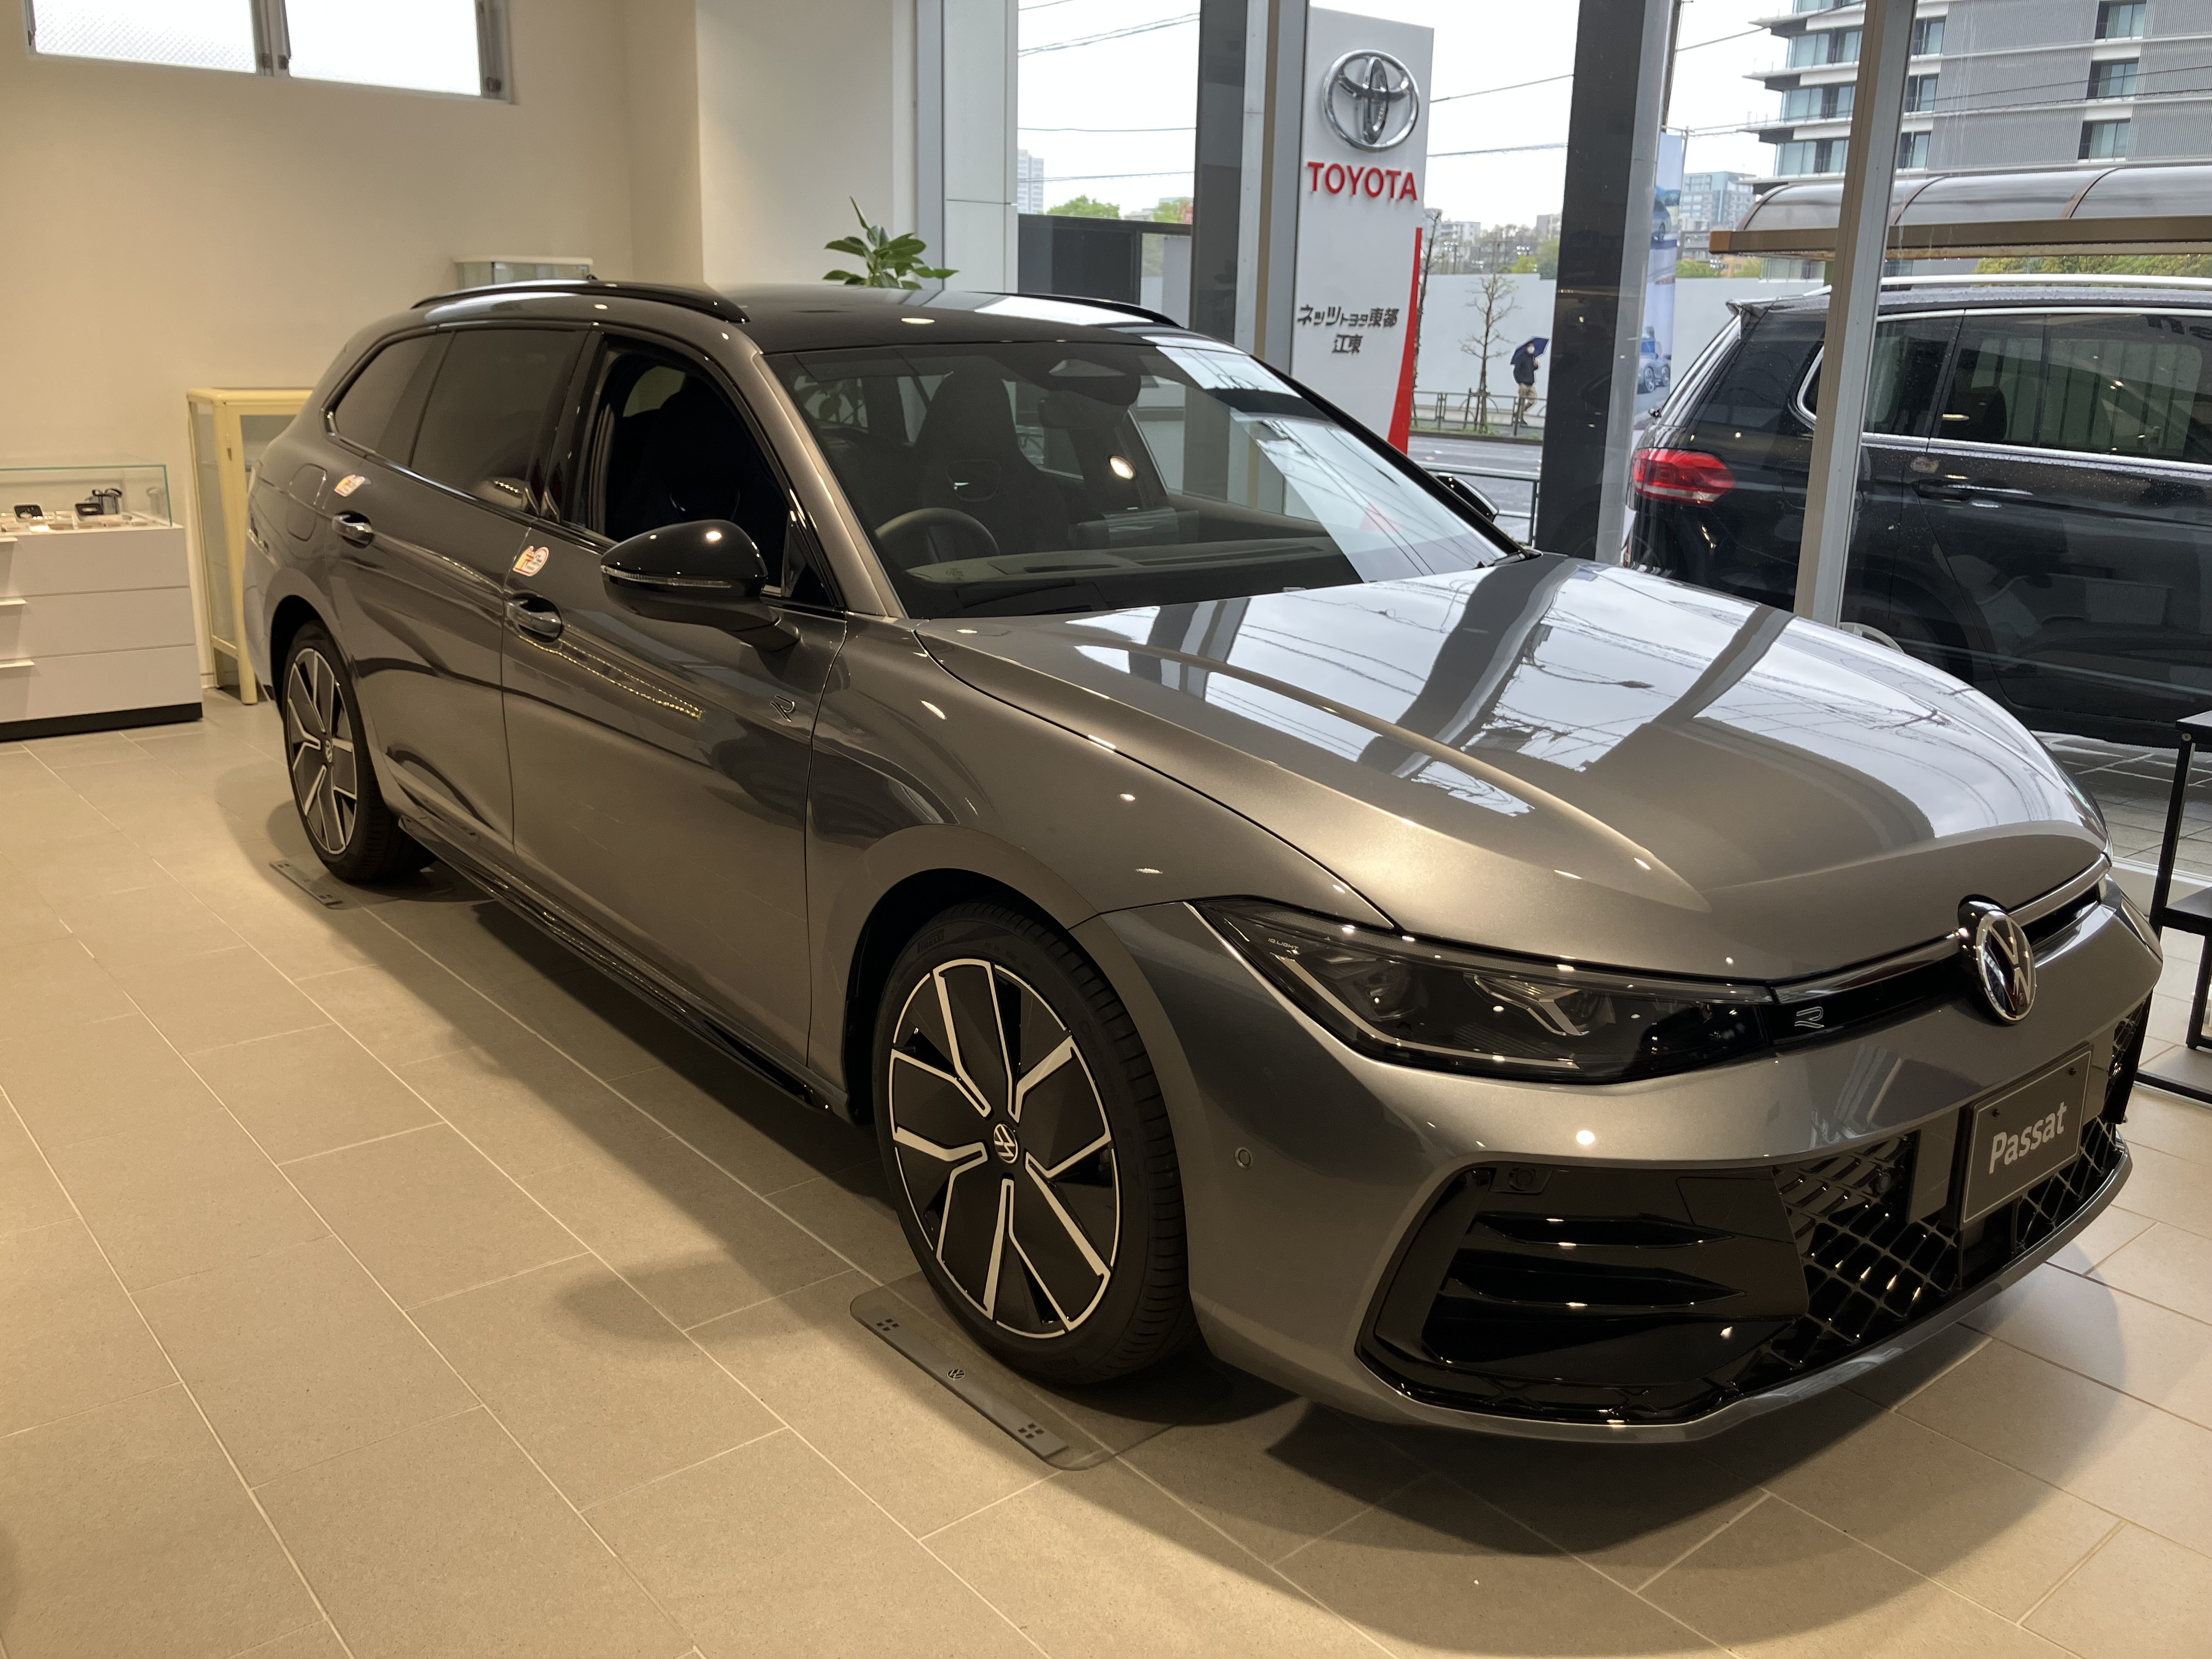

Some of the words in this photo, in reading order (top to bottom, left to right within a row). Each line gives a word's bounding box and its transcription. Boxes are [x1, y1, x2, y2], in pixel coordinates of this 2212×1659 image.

[1308, 161, 1418, 201] TOYOTA
[1297, 304, 1400, 327] ネッツトヨタ東都
[1331, 334, 1363, 354] 江東
[917, 929, 945, 954] PIRELLI
[1268, 938, 1299, 950] IQ.LIGHT
[1989, 1101, 2067, 1175] Passat
